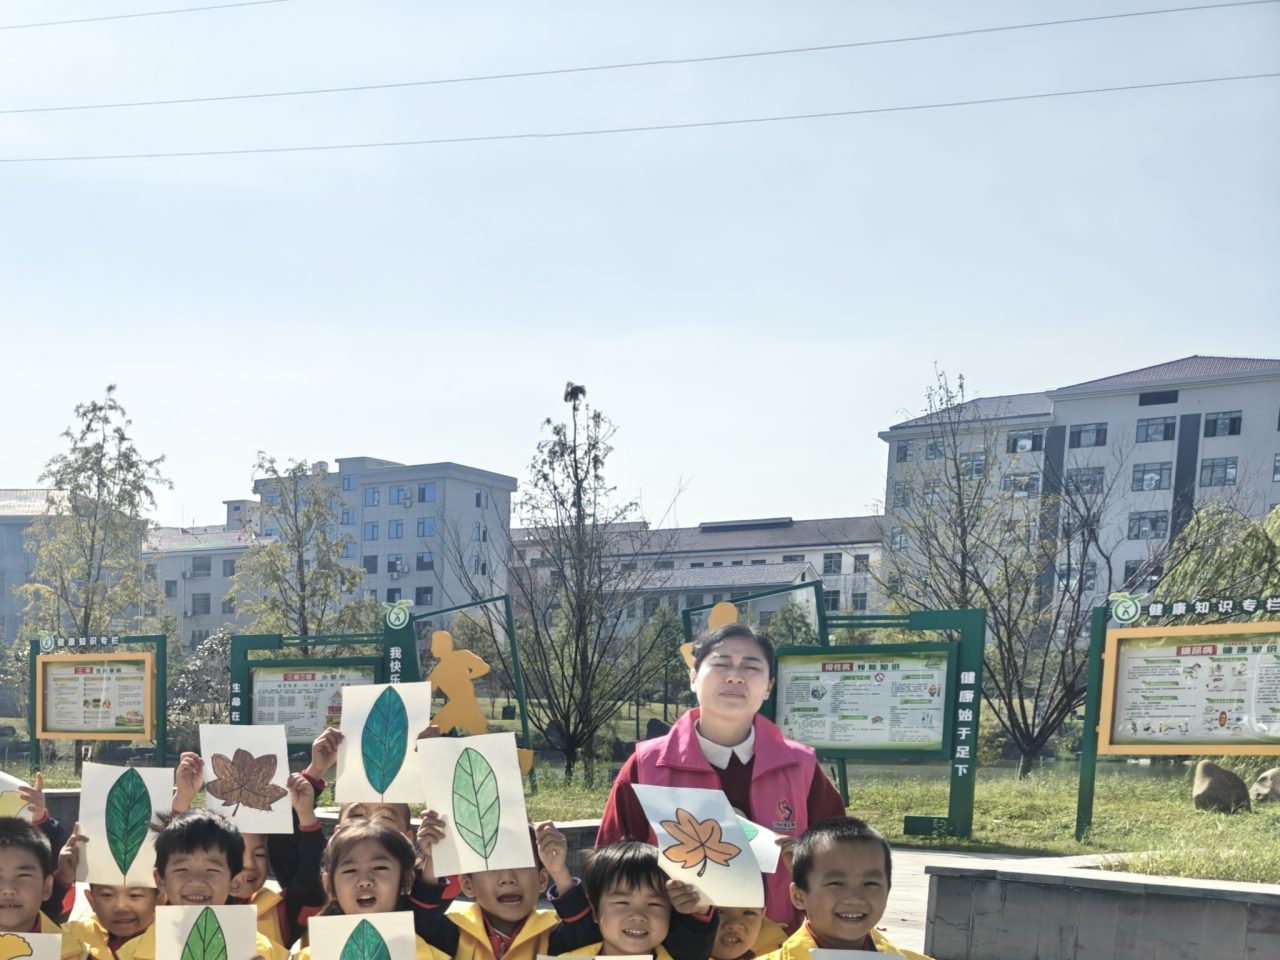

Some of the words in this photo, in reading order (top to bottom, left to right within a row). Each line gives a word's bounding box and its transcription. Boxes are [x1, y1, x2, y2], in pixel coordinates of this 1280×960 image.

[1148, 597, 1280, 616] 健康知识专栏
[231, 683, 241, 721] 生命在
[954, 671, 976, 777] 健康始于足下
